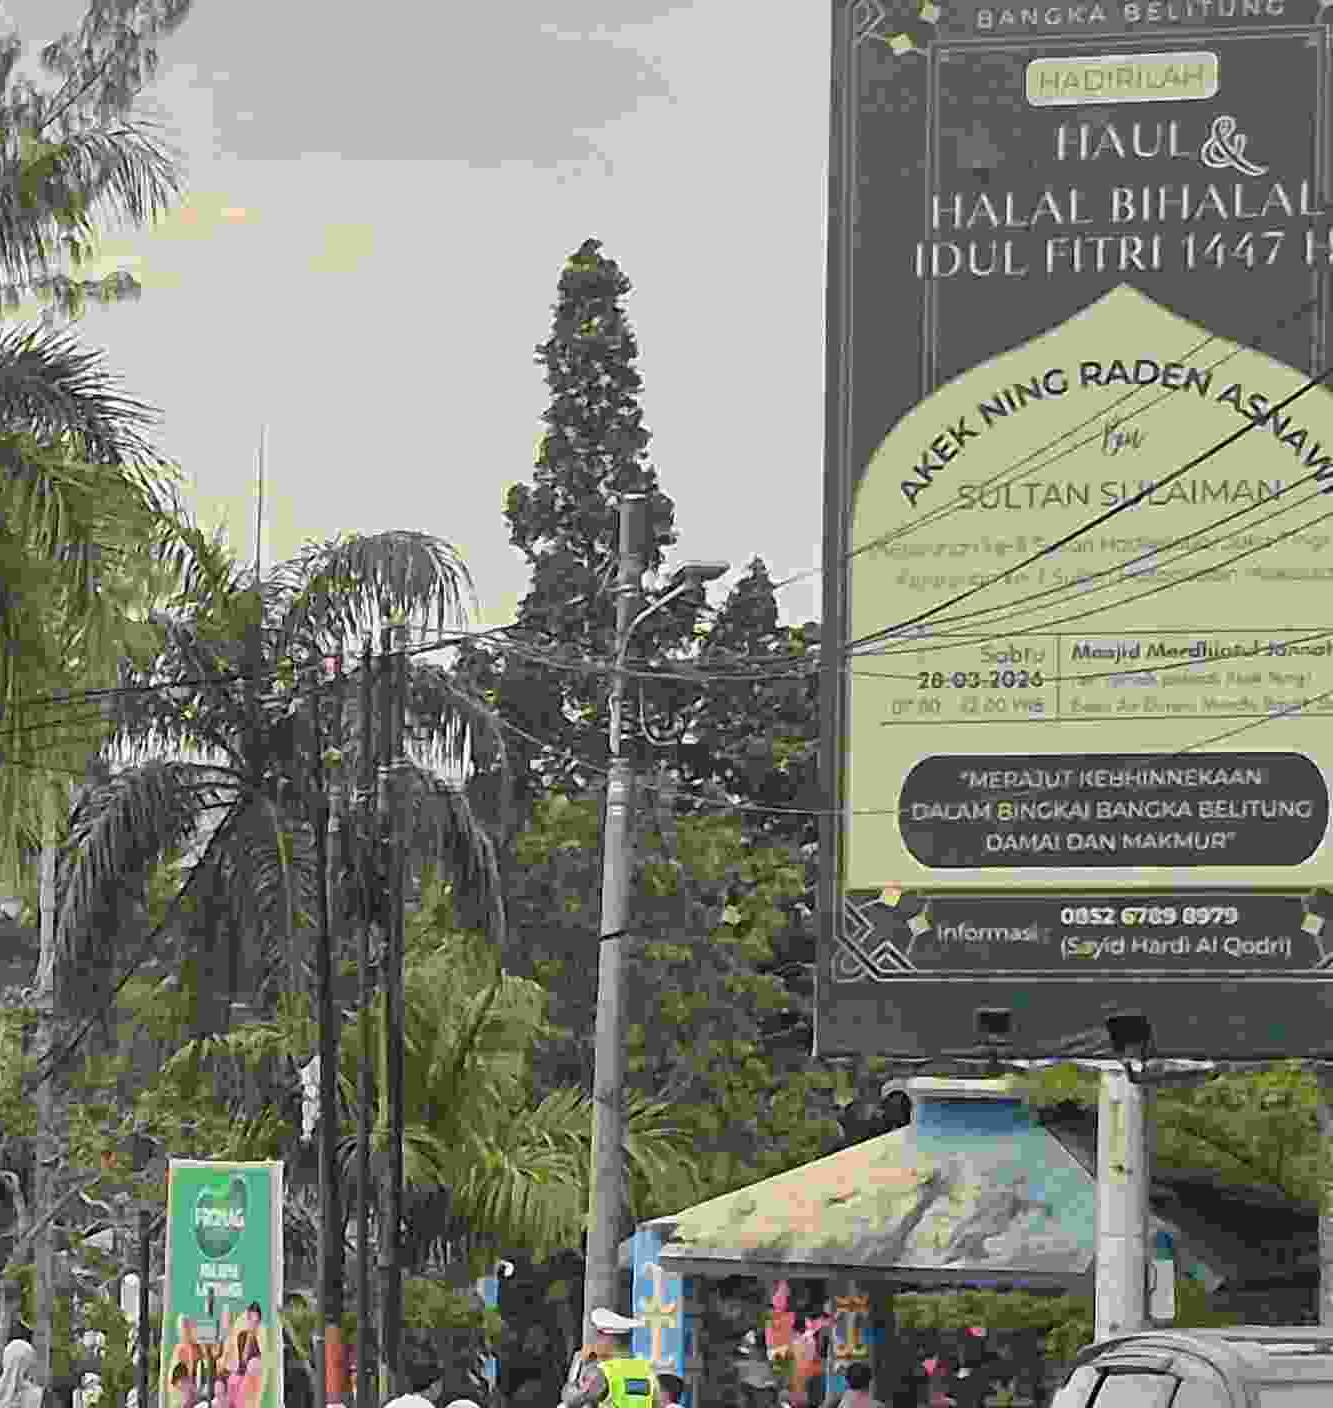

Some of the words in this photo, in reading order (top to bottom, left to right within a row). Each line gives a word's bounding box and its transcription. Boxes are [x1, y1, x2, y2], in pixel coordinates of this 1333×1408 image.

[977, 5, 1107, 29] BANGKA
[1039, 64, 1204, 92] HADIRILAH
[1056, 121, 1189, 160] HAUL
[1200, 115, 1268, 175] &
[932, 187, 1093, 229] HALAL
[1110, 182, 1325, 224] BIHALAL
[916, 239, 1029, 278] IDUL
[1046, 233, 1162, 272] FITRI
[1182, 230, 1285, 270] 1447
[900, 416, 980, 507] AKEK
[977, 368, 1069, 428] NING
[1078, 359, 1214, 397] RADEN
[958, 482, 1089, 510] SULTAN
[1100, 479, 1281, 508] SULAIMAN
[981, 643, 1046, 666] Sabtu
[1071, 639, 1141, 664] Masjid
[909, 801, 990, 822] DALAM
[997, 800, 1091, 821] BINGKAI
[1095, 800, 1192, 820] BANGKA
[1197, 799, 1313, 819] BELITUNG
[985, 832, 1061, 852] DAMAI
[1066, 832, 1116, 851] DAN
